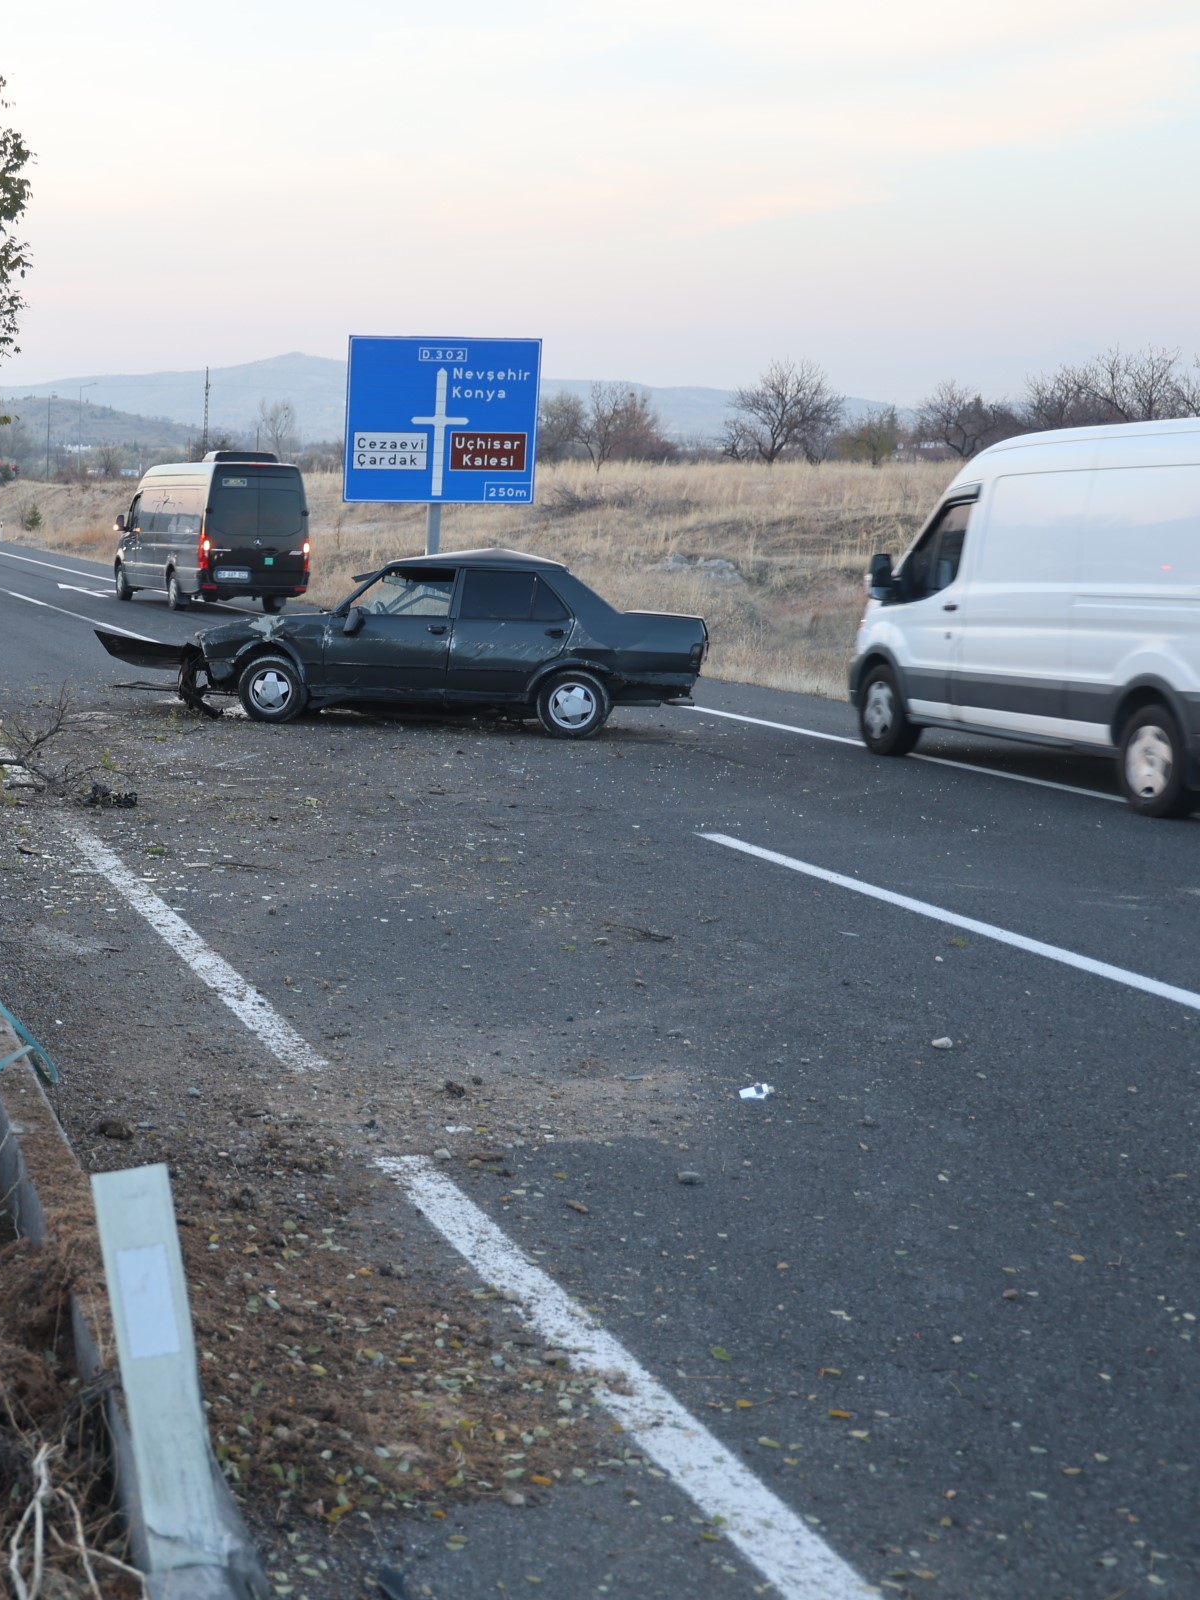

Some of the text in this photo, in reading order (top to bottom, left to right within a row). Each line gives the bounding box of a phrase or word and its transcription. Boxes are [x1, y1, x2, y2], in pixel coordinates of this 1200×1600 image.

[422, 350, 464, 360] D.302
[453, 367, 530, 381] Nevşehir
[452, 386, 506, 401] Konya
[357, 437, 425, 450] Cezaevi
[455, 437, 521, 451] Uçhisar
[357, 453, 417, 467] Çardak
[462, 454, 514, 466] Kalesi
